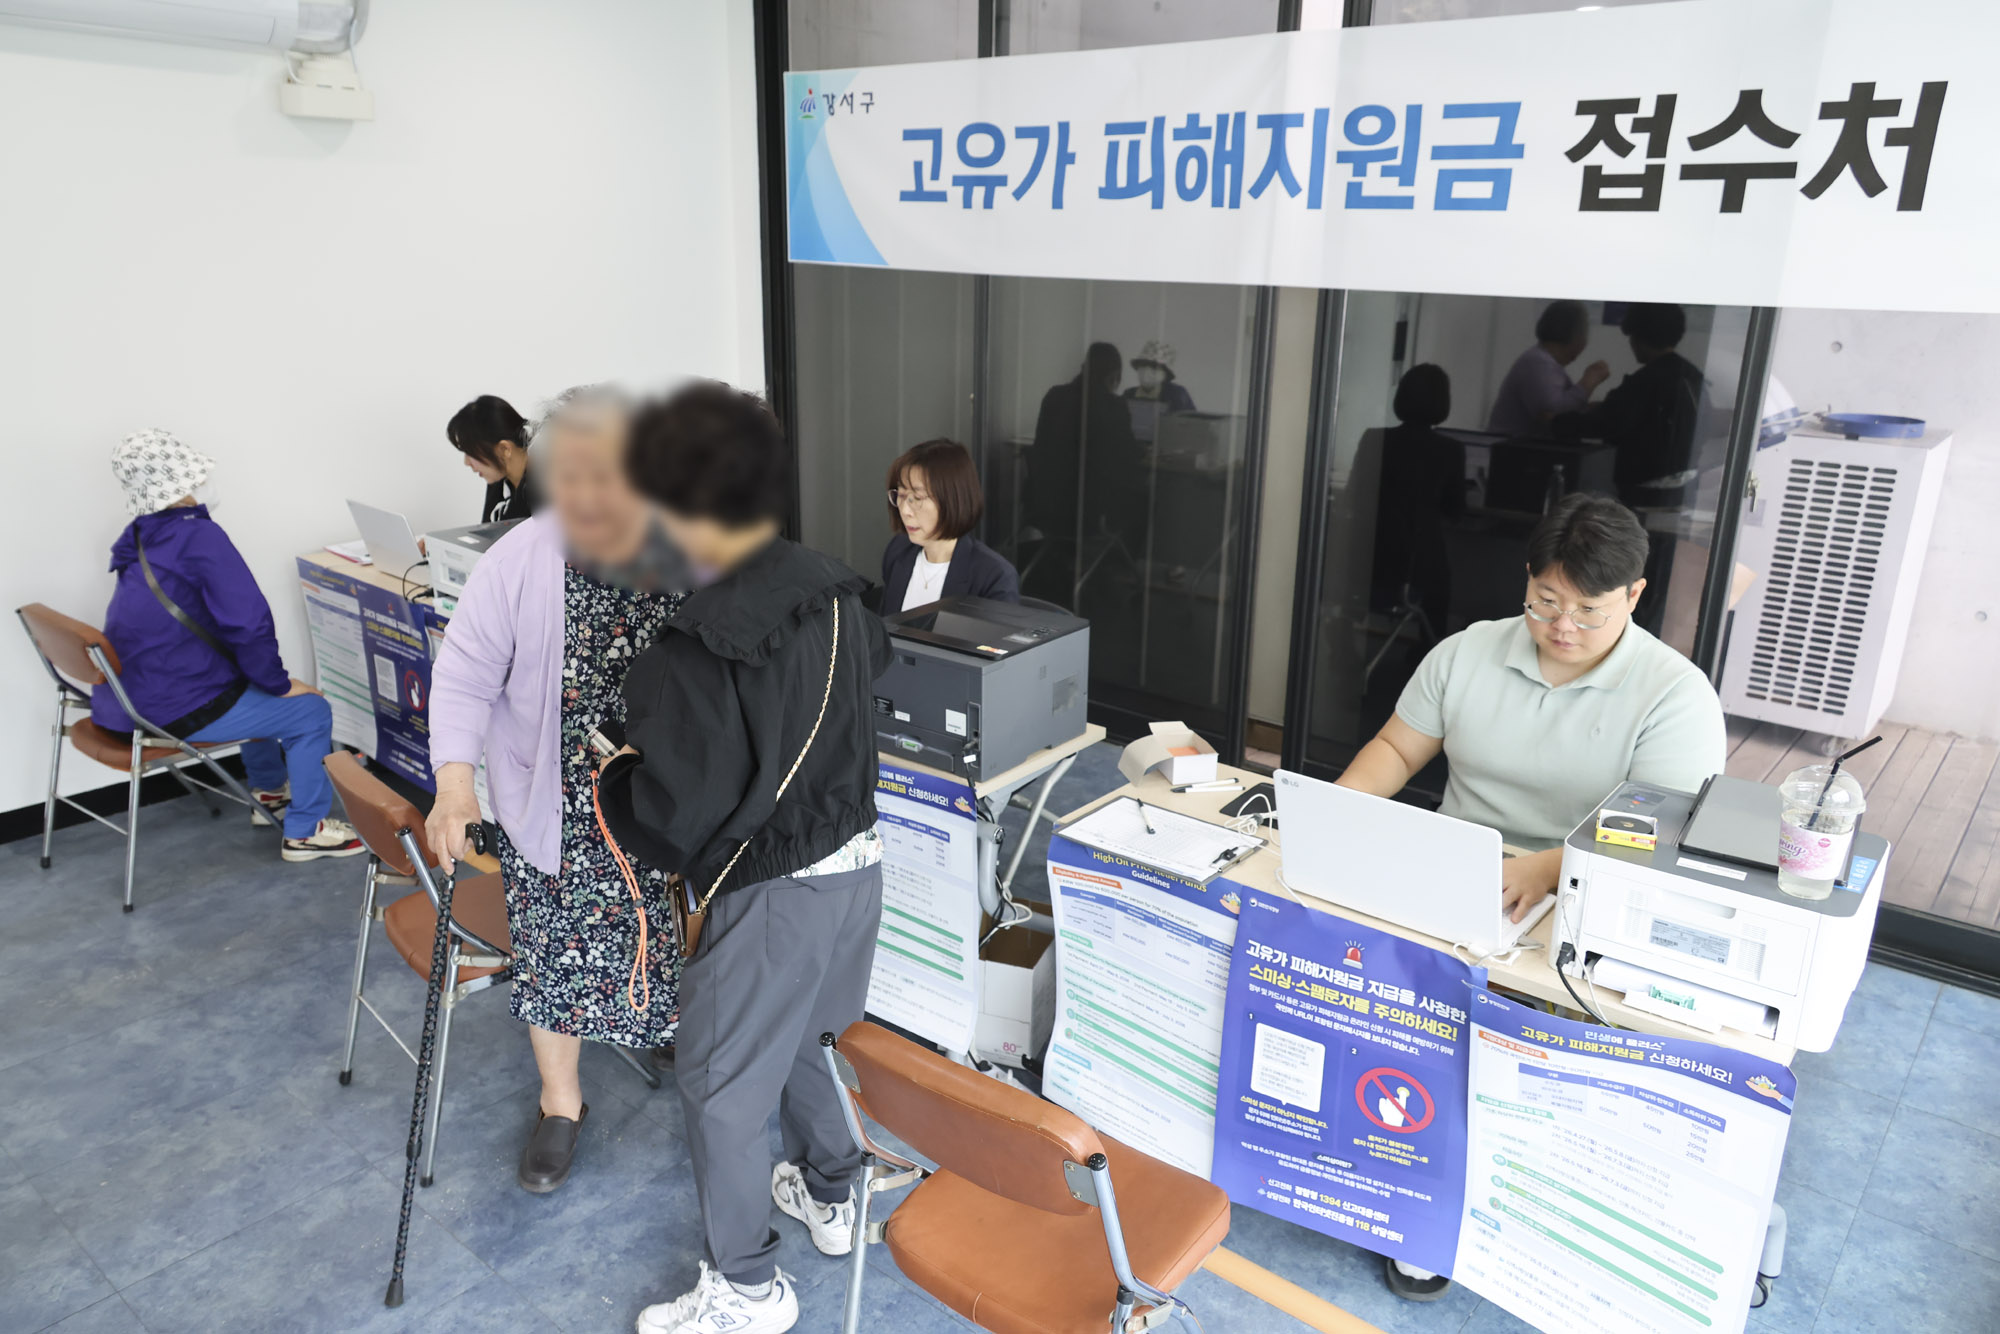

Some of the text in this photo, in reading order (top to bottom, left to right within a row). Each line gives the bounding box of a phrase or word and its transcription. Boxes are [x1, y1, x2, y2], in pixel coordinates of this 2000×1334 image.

[822, 91, 875, 116] 강서구
[899, 81, 1948, 213] 고유가 피해지원금 접수처
[1093, 851, 1115, 864] High
[1131, 870, 1170, 889] Guidelines
[1245, 939, 1289, 967] 고유가
[1289, 956, 1365, 992] 피해지원금
[1367, 980, 1416, 1007] 지급을
[1418, 996, 1467, 1025] 사칭한
[1249, 964, 1370, 1015] 스미싱·스팸문자를
[1373, 1003, 1458, 1042] 주의하세요!
[1299, 1001, 1318, 1013] 고유가
[1294, 1009, 1314, 1022] URL이
[1002, 1041, 1017, 1053] 80
[1584, 1031, 1623, 1045] 민생에
[1520, 1025, 1733, 1084] 고유가 피해지원금 신청하세요!
[1707, 1117, 1722, 1127] 70%
[1267, 1178, 1292, 1192] 신고전화
[1319, 1194, 1341, 1208] 1394
[1342, 1201, 1390, 1224] 신고대응센터
[1355, 1219, 1370, 1231] 118
[1371, 1224, 1404, 1244] 상담센터
[710, 1312, 736, 1329] N
